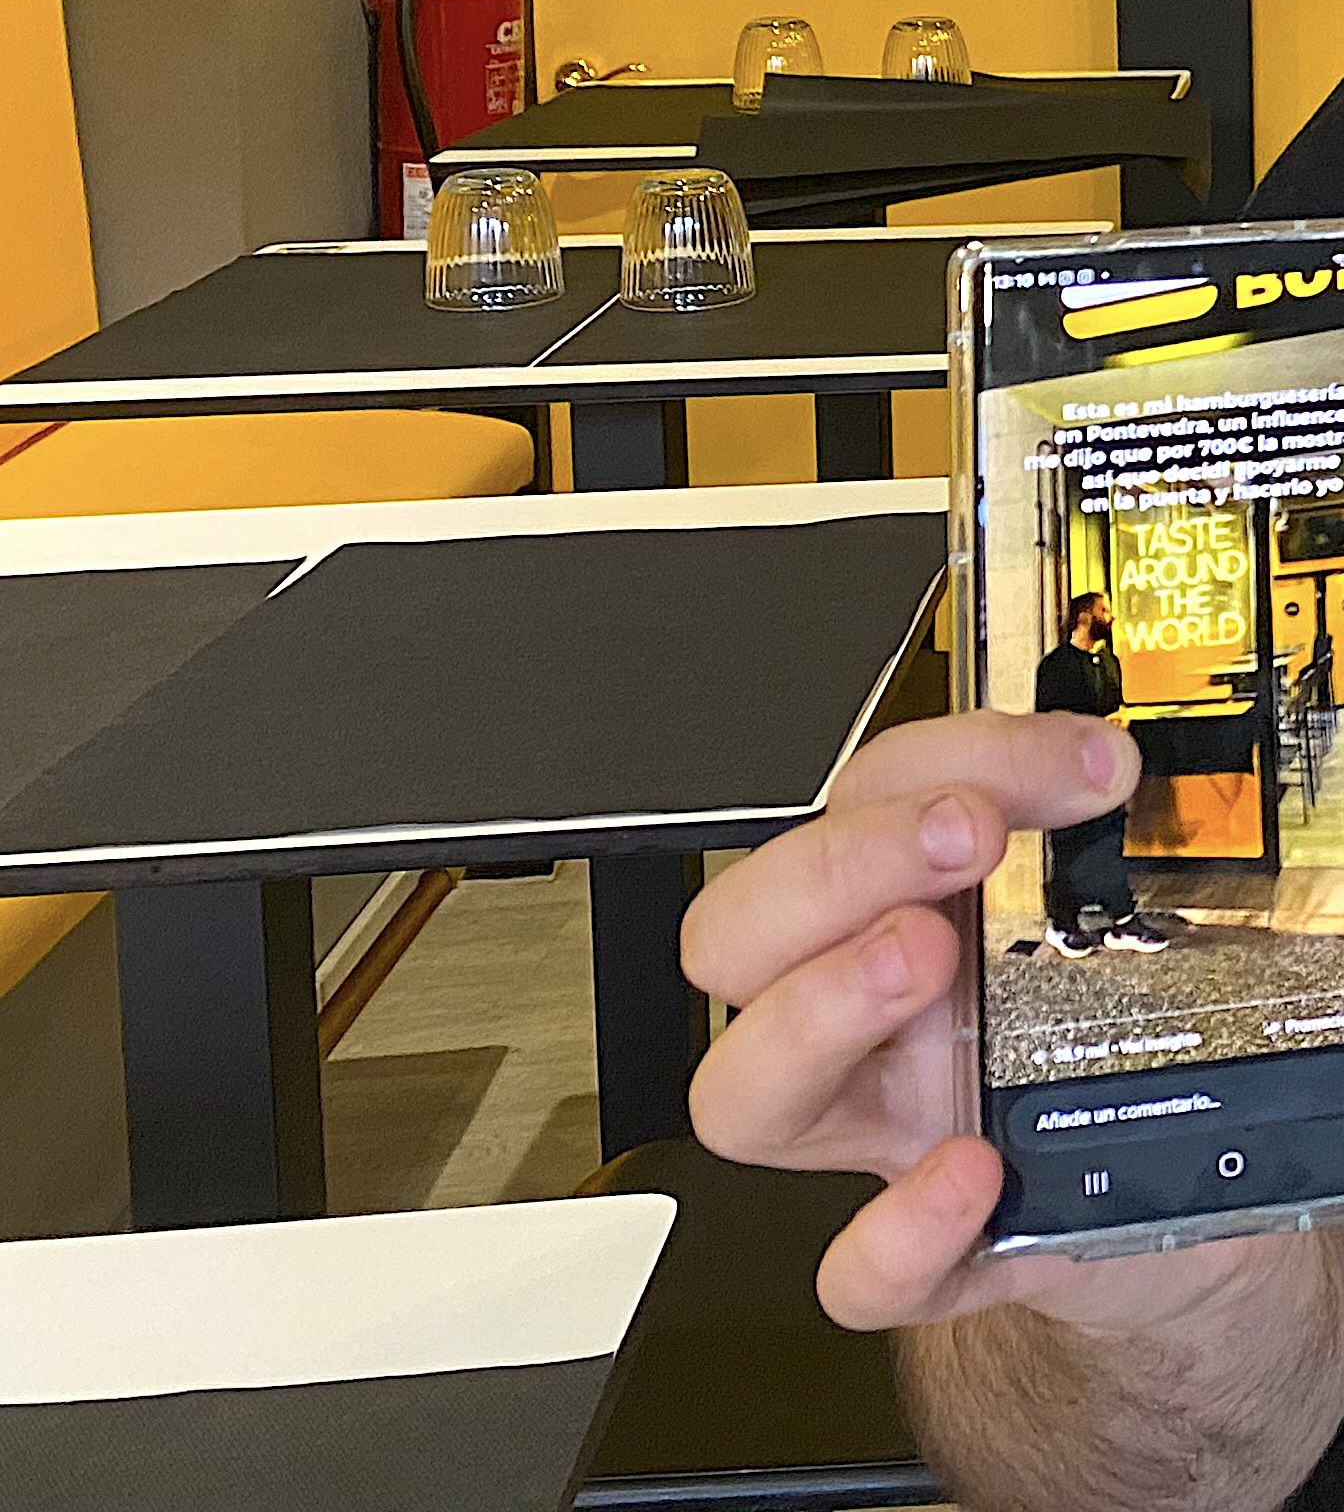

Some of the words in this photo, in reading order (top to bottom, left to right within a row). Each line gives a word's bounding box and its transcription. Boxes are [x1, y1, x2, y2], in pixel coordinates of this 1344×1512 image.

[1062, 402, 1110, 421] Esta
[1114, 401, 1139, 417] es
[1143, 395, 1172, 415] mi
[1054, 428, 1083, 445] en
[1086, 418, 1214, 442] Pontevedra,
[1217, 416, 1247, 432] un
[1024, 453, 1061, 471] me
[1063, 447, 1107, 470] dijo
[1110, 447, 1153, 467] que
[1156, 443, 1195, 464] por
[1198, 436, 1254, 457] 700€
[1257, 433, 1278, 452] la
[1114, 469, 1162, 490] que
[1233, 453, 1341, 483] apoyarme
[1080, 496, 1109, 513] en
[1114, 491, 1136, 511] la
[1138, 488, 1211, 512] puerta
[1214, 487, 1231, 506] y
[1232, 477, 1314, 500] hacerlo
[1315, 476, 1344, 497] yo
[1132, 513, 1236, 557] TASTE
[1119, 549, 1248, 592] AROUND
[1154, 584, 1213, 617] THE
[1125, 610, 1247, 653] WORLD
[1036, 1106, 1092, 1131] Añade
[1093, 1107, 1116, 1125] un
